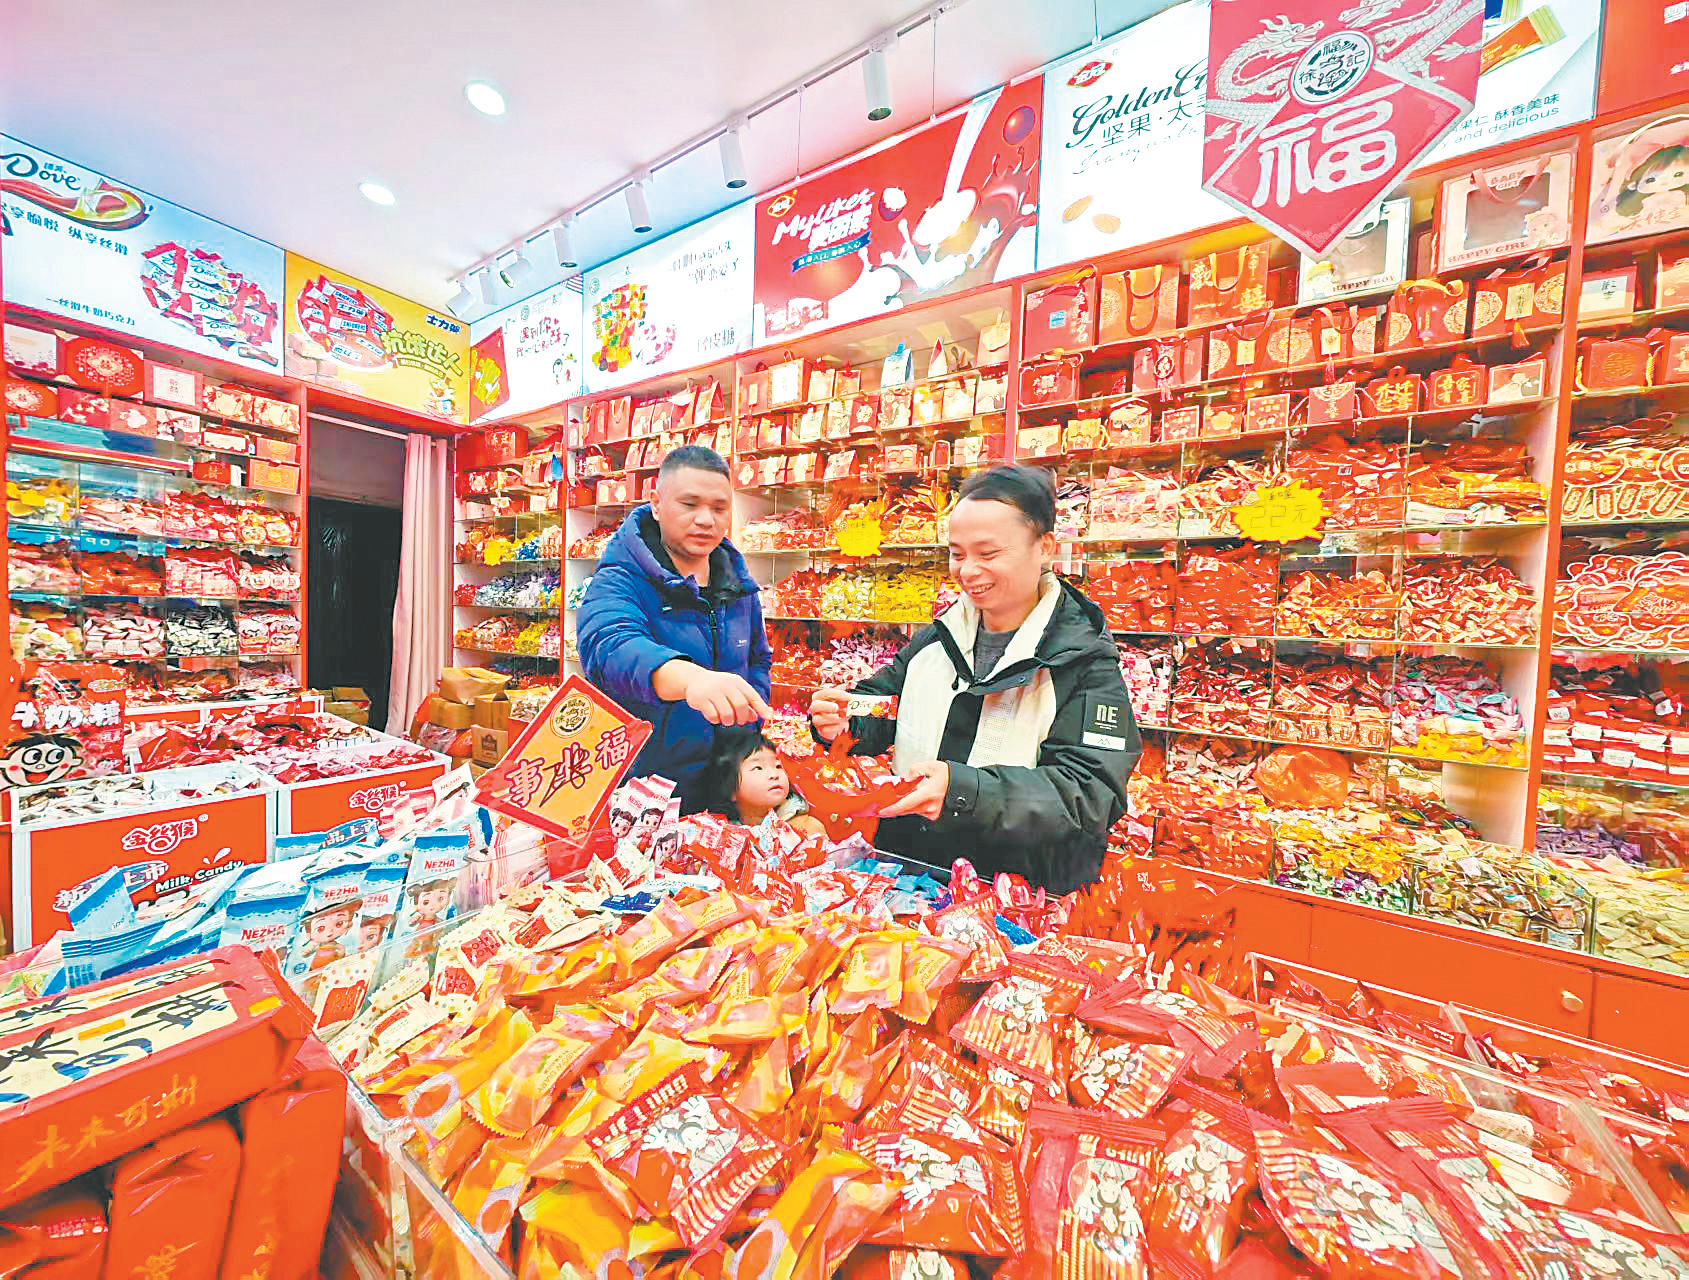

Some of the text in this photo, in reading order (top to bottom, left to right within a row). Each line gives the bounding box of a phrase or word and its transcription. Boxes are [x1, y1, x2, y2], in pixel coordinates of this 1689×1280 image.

[1066, 57, 1209, 148] Golden Cr
[1101, 95, 1206, 148] 坚果·太
[1450, 115, 1489, 135] 果仁
[1453, 129, 1483, 143] and
[1488, 106, 1560, 133] delicious
[1251, 84, 1407, 208] 福
[0, 152, 81, 190] Dove
[772, 188, 875, 246] Mylikes
[1495, 241, 1529, 254] GIRL
[426, 314, 462, 334] 士力架
[122, 818, 198, 854] 金丝猴
[154, 860, 245, 894] Milk Candy
[424, 859, 456, 871] NEZHA
[55, 861, 168, 909] 新上市
